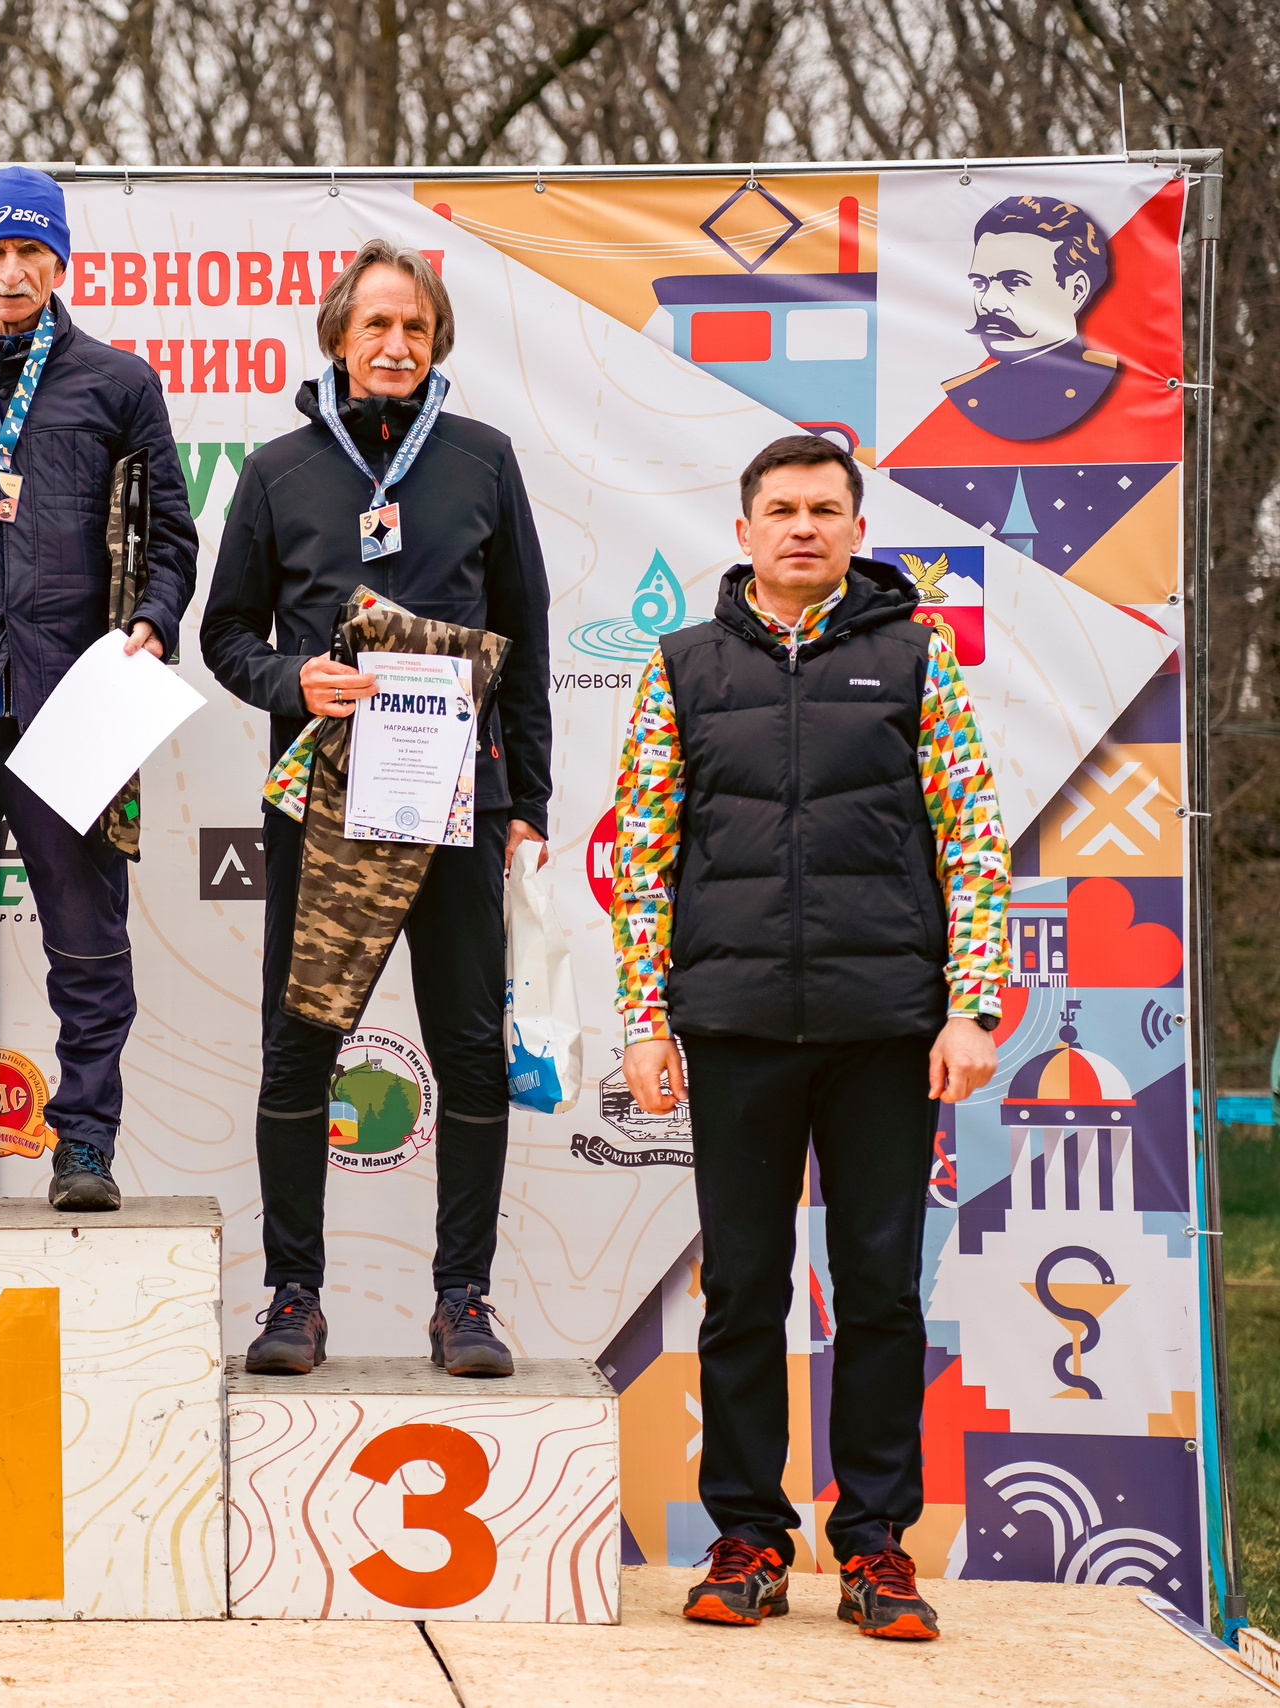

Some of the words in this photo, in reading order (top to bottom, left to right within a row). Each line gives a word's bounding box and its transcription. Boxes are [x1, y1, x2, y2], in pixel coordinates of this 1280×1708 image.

[11, 206, 50, 229] asics
[363, 515, 373, 530] 3
[549, 673, 632, 693] улевая
[849, 678, 881, 687] STROBBS
[369, 692, 447, 716] ГРАМОТА
[383, 724, 439, 734] НАГРАЖДАЕТСЯ
[341, 1034, 365, 1047] ога
[368, 1034, 405, 1054] город
[405, 1049, 432, 1117] Пятигорск
[27, 1069, 44, 1119] традиции
[330, 1150, 359, 1167] гора
[362, 1150, 406, 1168] Машук
[348, 1423, 498, 1610] 3
